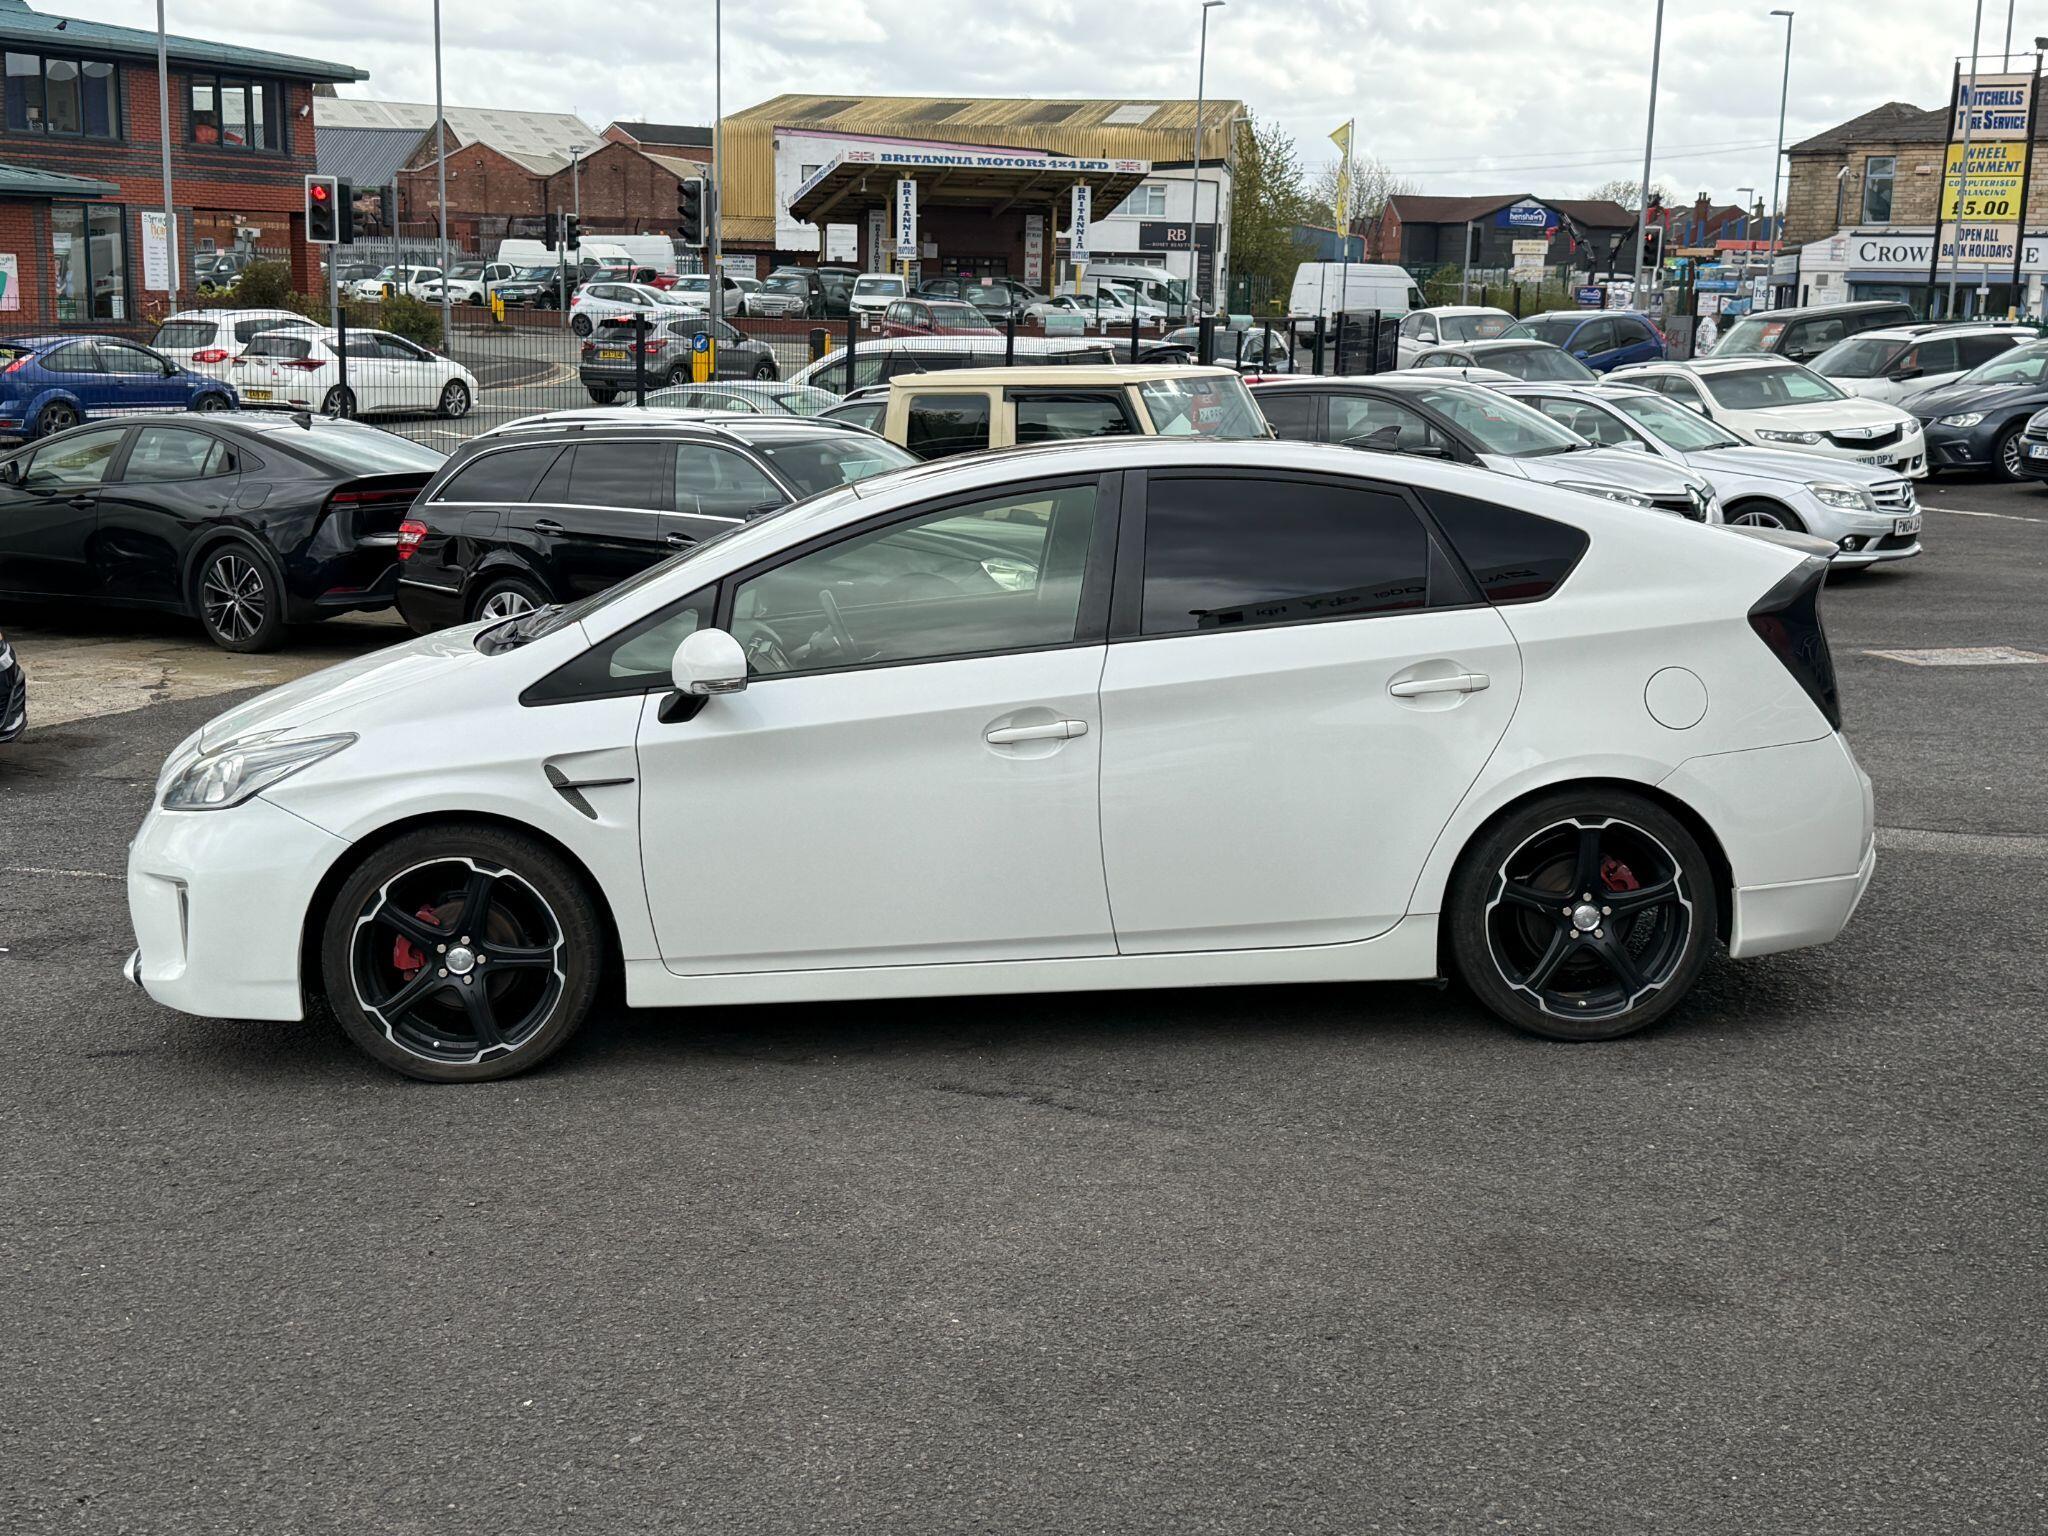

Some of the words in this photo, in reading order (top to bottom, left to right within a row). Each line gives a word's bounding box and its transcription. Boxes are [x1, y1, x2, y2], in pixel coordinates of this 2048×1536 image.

[1958, 111, 1982, 130] TRE
[1983, 111, 2026, 130] SERVICE
[880, 153, 974, 165] BRITANNIA
[976, 157, 1047, 168] MOTORS
[1079, 161, 1109, 170] LTD
[1949, 161, 2021, 174] ALGNMENT
[902, 182, 912, 245] BRITANNIA
[1075, 187, 1086, 249] BRITANNIA
[1509, 211, 1542, 222] henshaws
[1167, 229, 1187, 241] RB
[1960, 228, 1981, 241] OPEN
[1984, 229, 1999, 241] ALL
[1968, 244, 2013, 258] HOLIDAYS
[1877, 454, 1894, 465] DPX
